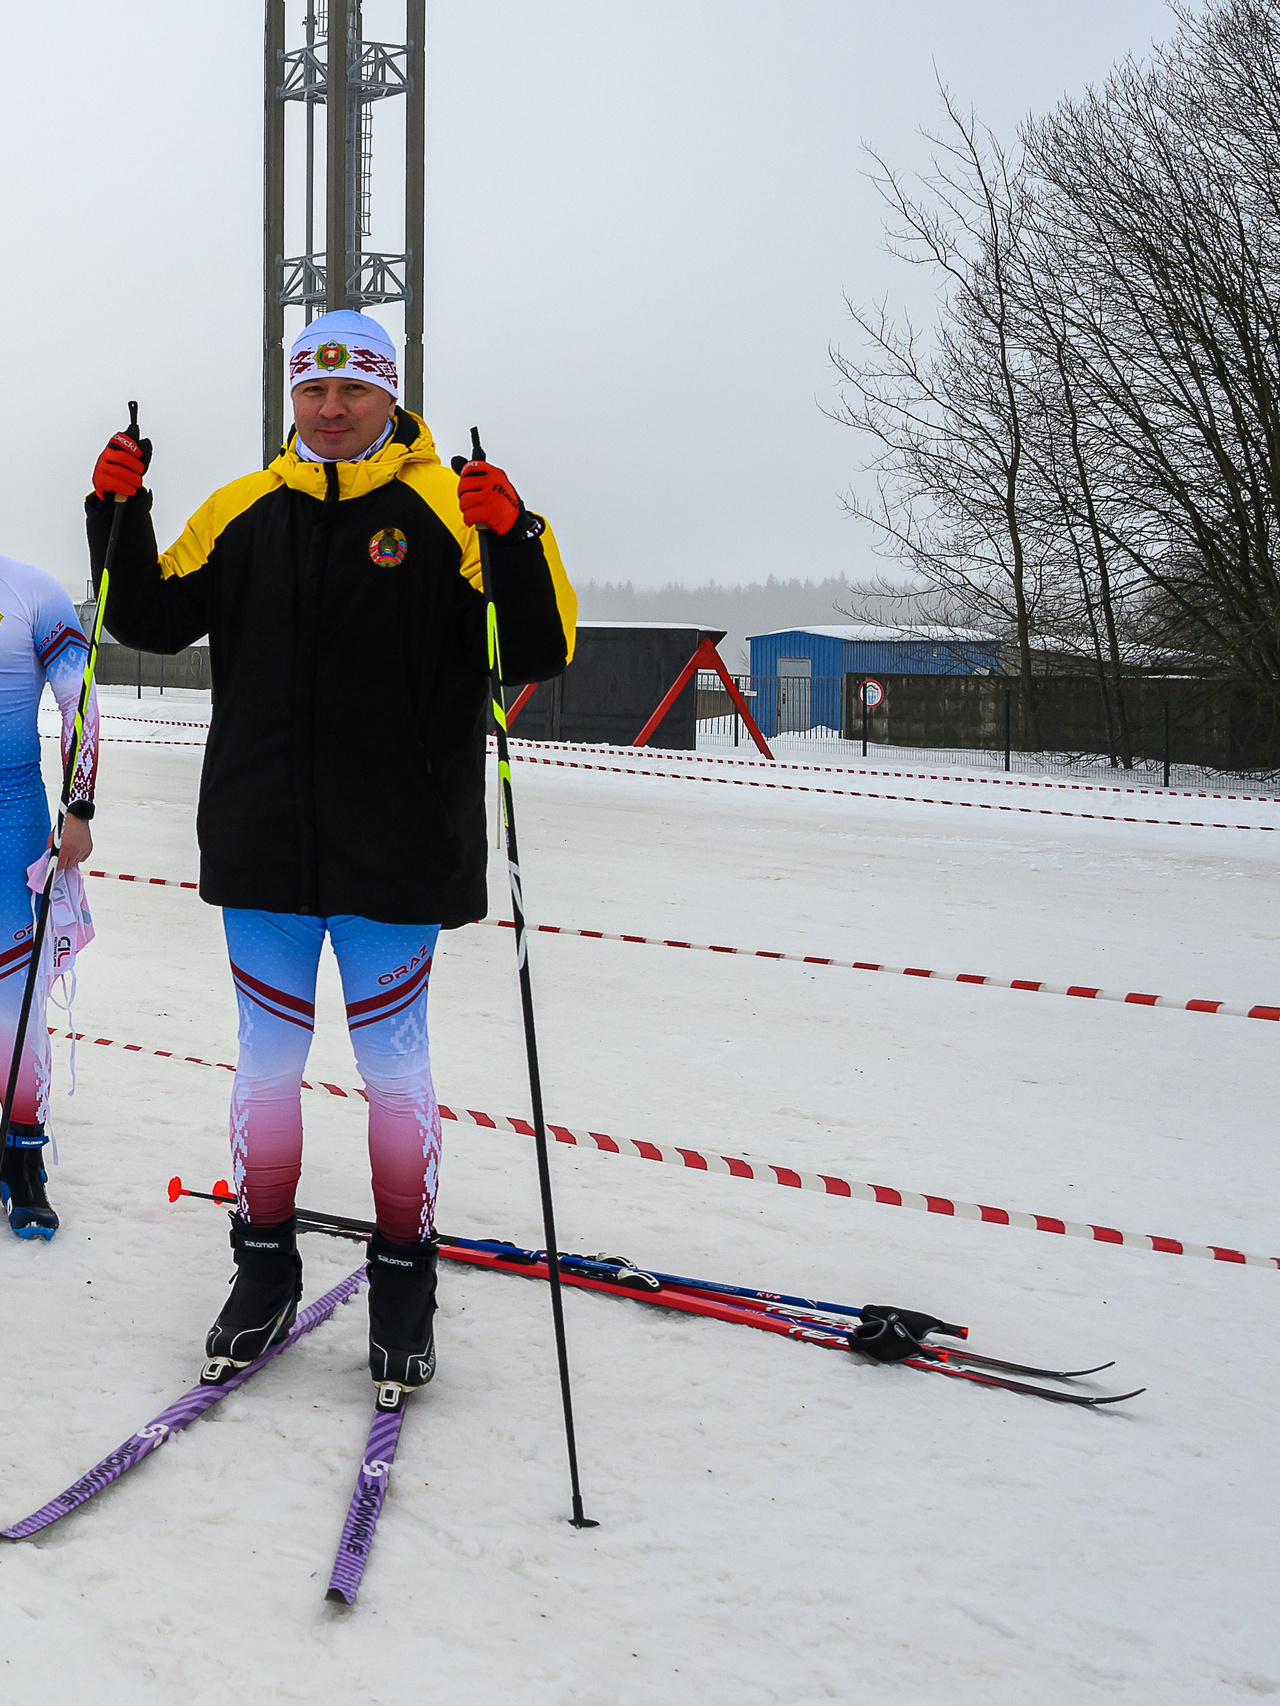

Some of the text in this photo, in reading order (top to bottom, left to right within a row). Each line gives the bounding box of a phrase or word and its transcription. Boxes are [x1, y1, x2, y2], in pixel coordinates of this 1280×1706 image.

[377, 944, 429, 986] ORAZ
[60, 1442, 141, 1506] SNOWWAVE
[346, 1481, 380, 1556] SNOWWAVE
